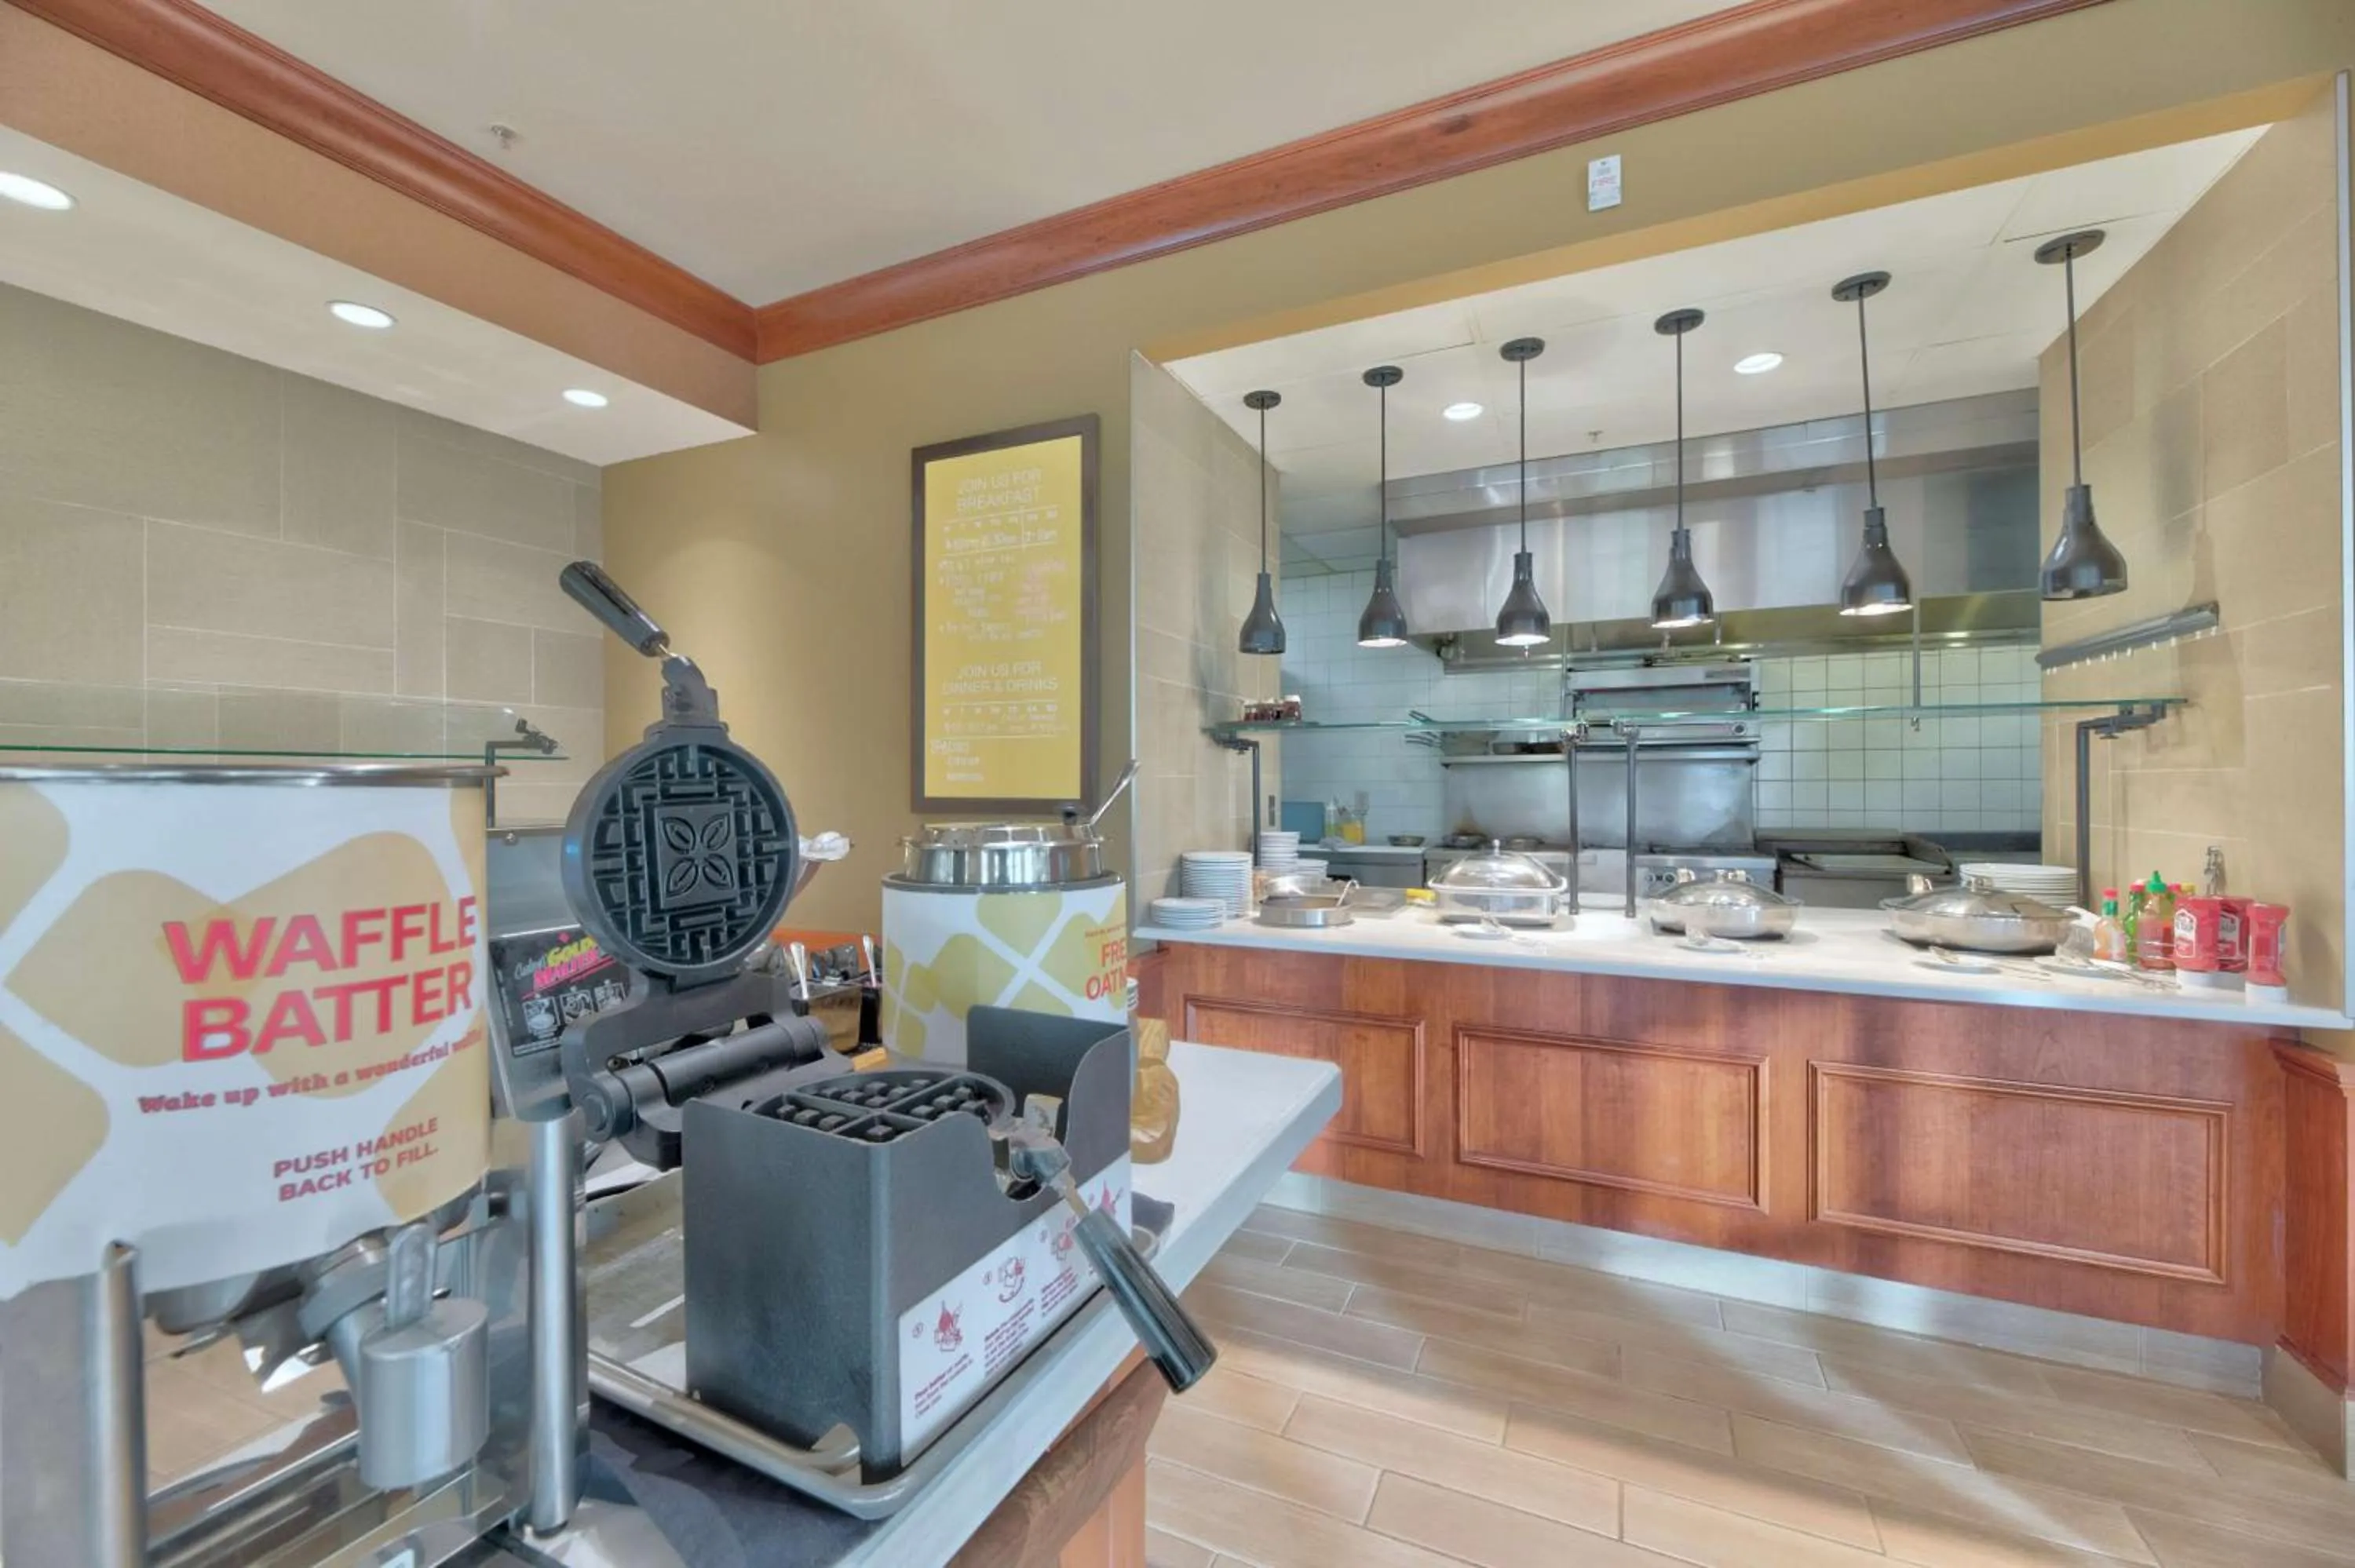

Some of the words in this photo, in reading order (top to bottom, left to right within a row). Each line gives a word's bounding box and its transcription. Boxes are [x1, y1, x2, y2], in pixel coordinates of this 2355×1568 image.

[162, 895, 476, 984] WAFFLE
[182, 960, 473, 1063] BATTER
[138, 1092, 217, 1114] Wake
[223, 1088, 260, 1107] up
[267, 1073, 330, 1098] with
[334, 1071, 348, 1087] a
[356, 1041, 449, 1082] wonderful
[273, 1146, 349, 1179] PUSH
[356, 1117, 439, 1159] HANDLE
[279, 1169, 352, 1202] BACK
[360, 1156, 390, 1180] TO
[396, 1141, 440, 1169] FILL.
